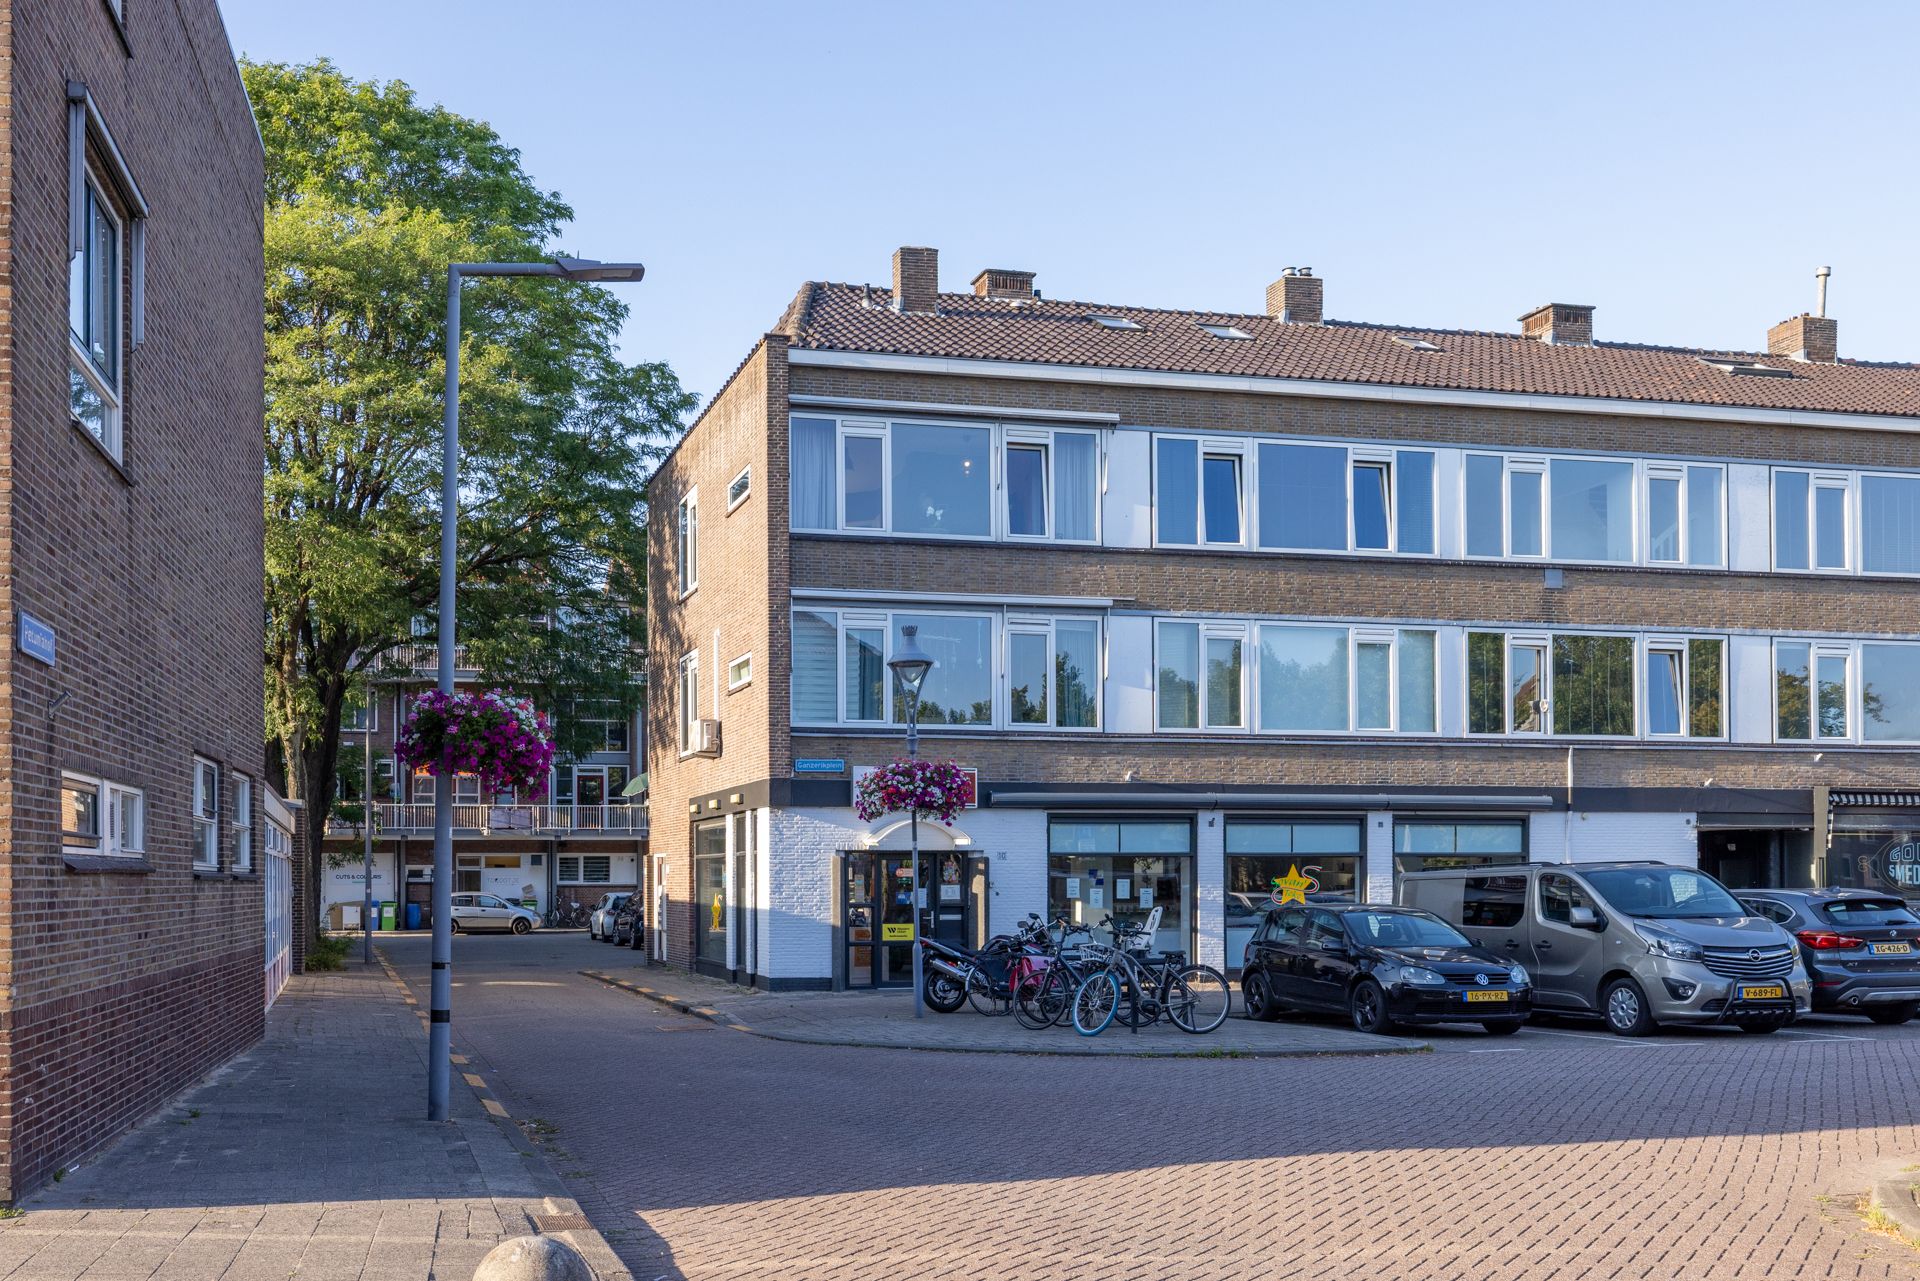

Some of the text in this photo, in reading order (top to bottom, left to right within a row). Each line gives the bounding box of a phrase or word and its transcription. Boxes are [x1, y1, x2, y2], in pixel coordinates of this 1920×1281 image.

[1890, 843, 1920, 862] GO
[1875, 944, 1908, 953] XG-426-D
[1470, 992, 1505, 1001] 16-PX-RZ
[1745, 988, 1780, 997] V-689-FL
